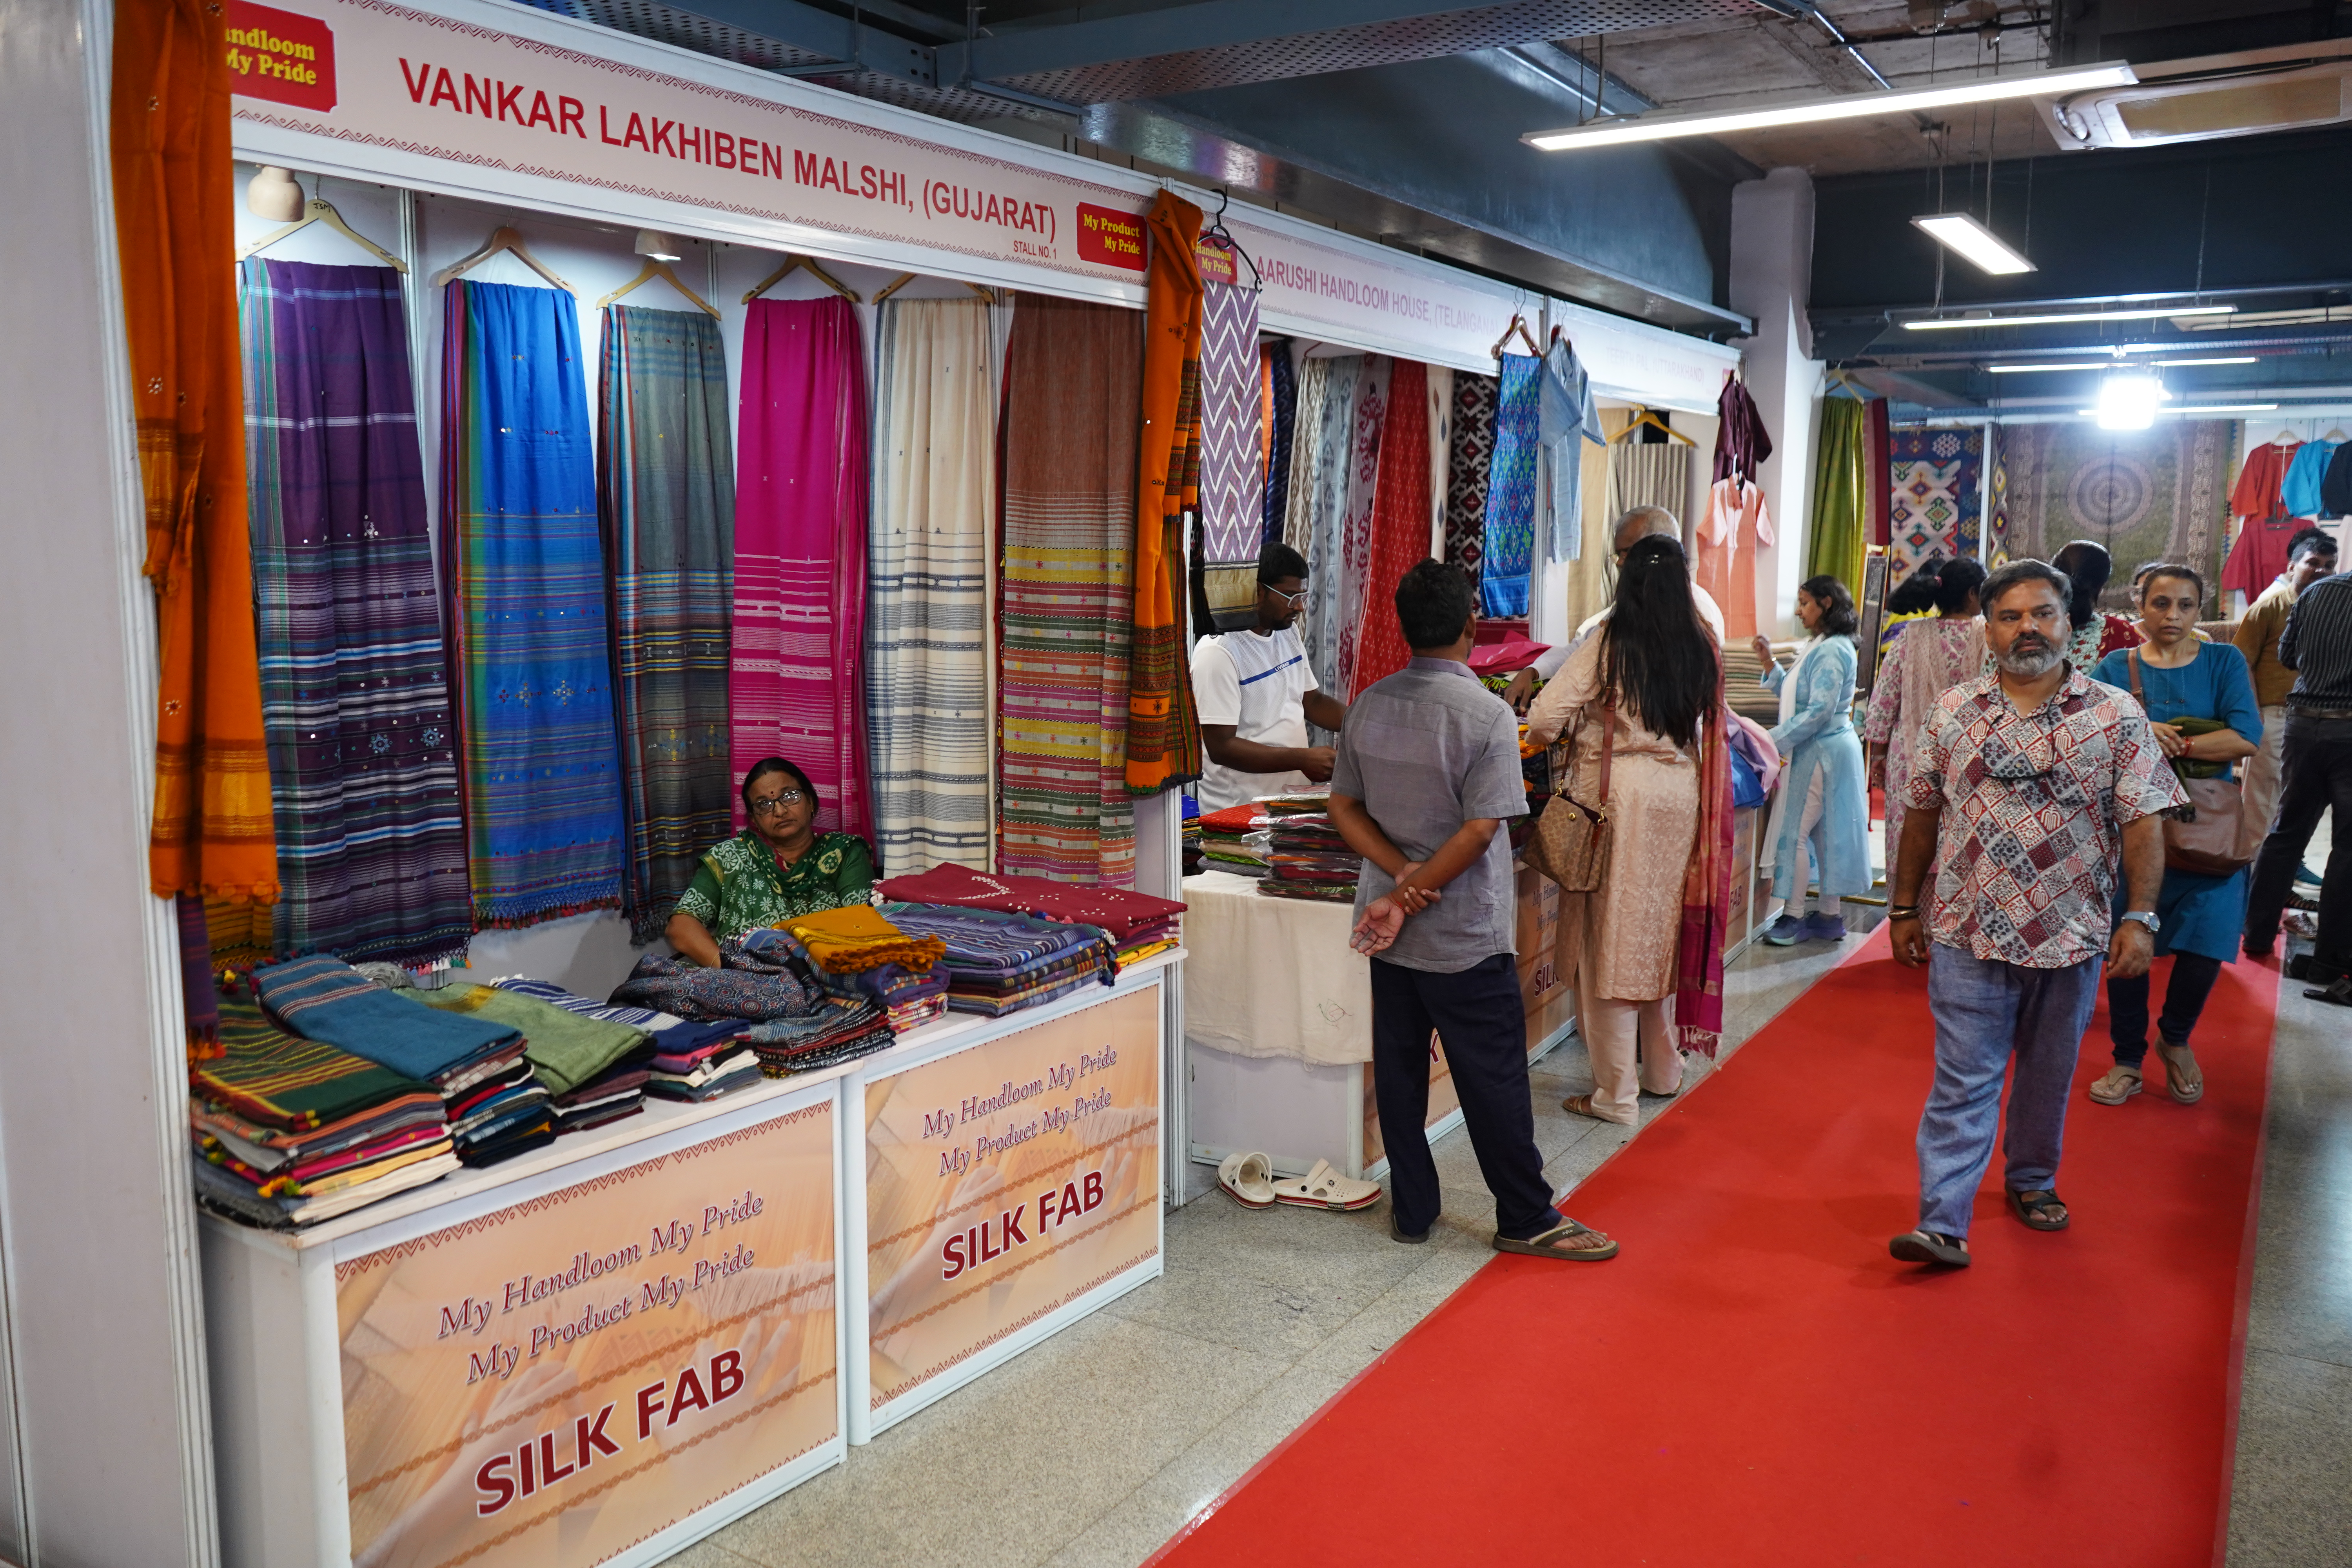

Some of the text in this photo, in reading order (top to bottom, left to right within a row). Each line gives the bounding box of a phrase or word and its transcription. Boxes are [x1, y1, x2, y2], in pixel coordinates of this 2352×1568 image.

[225, 28, 316, 61] ndloom
[257, 54, 316, 85] Pride
[399, 58, 1055, 243] VANKAR LAKHIBEN MALSHI, (GUJARAT)
[1014, 240, 1056, 259] STALL NO. 1
[1084, 213, 1140, 237] My Product
[1105, 236, 1140, 254] My Pride
[1196, 243, 1231, 262] Handloom
[1201, 257, 1232, 275] My Pride
[1257, 256, 1498, 337] AARUSHI HANDLOOM HOUSE, (TELANGANA)
[922, 1044, 1116, 1138] My Handloom My Pride
[939, 1086, 1111, 1176] My Product My Pride
[438, 1189, 763, 1339] My Handloom My Pride
[942, 1170, 1104, 1280] SILK FAB
[466, 1243, 754, 1385] My Product My Pride
[475, 1348, 745, 1516] SILK FAB
